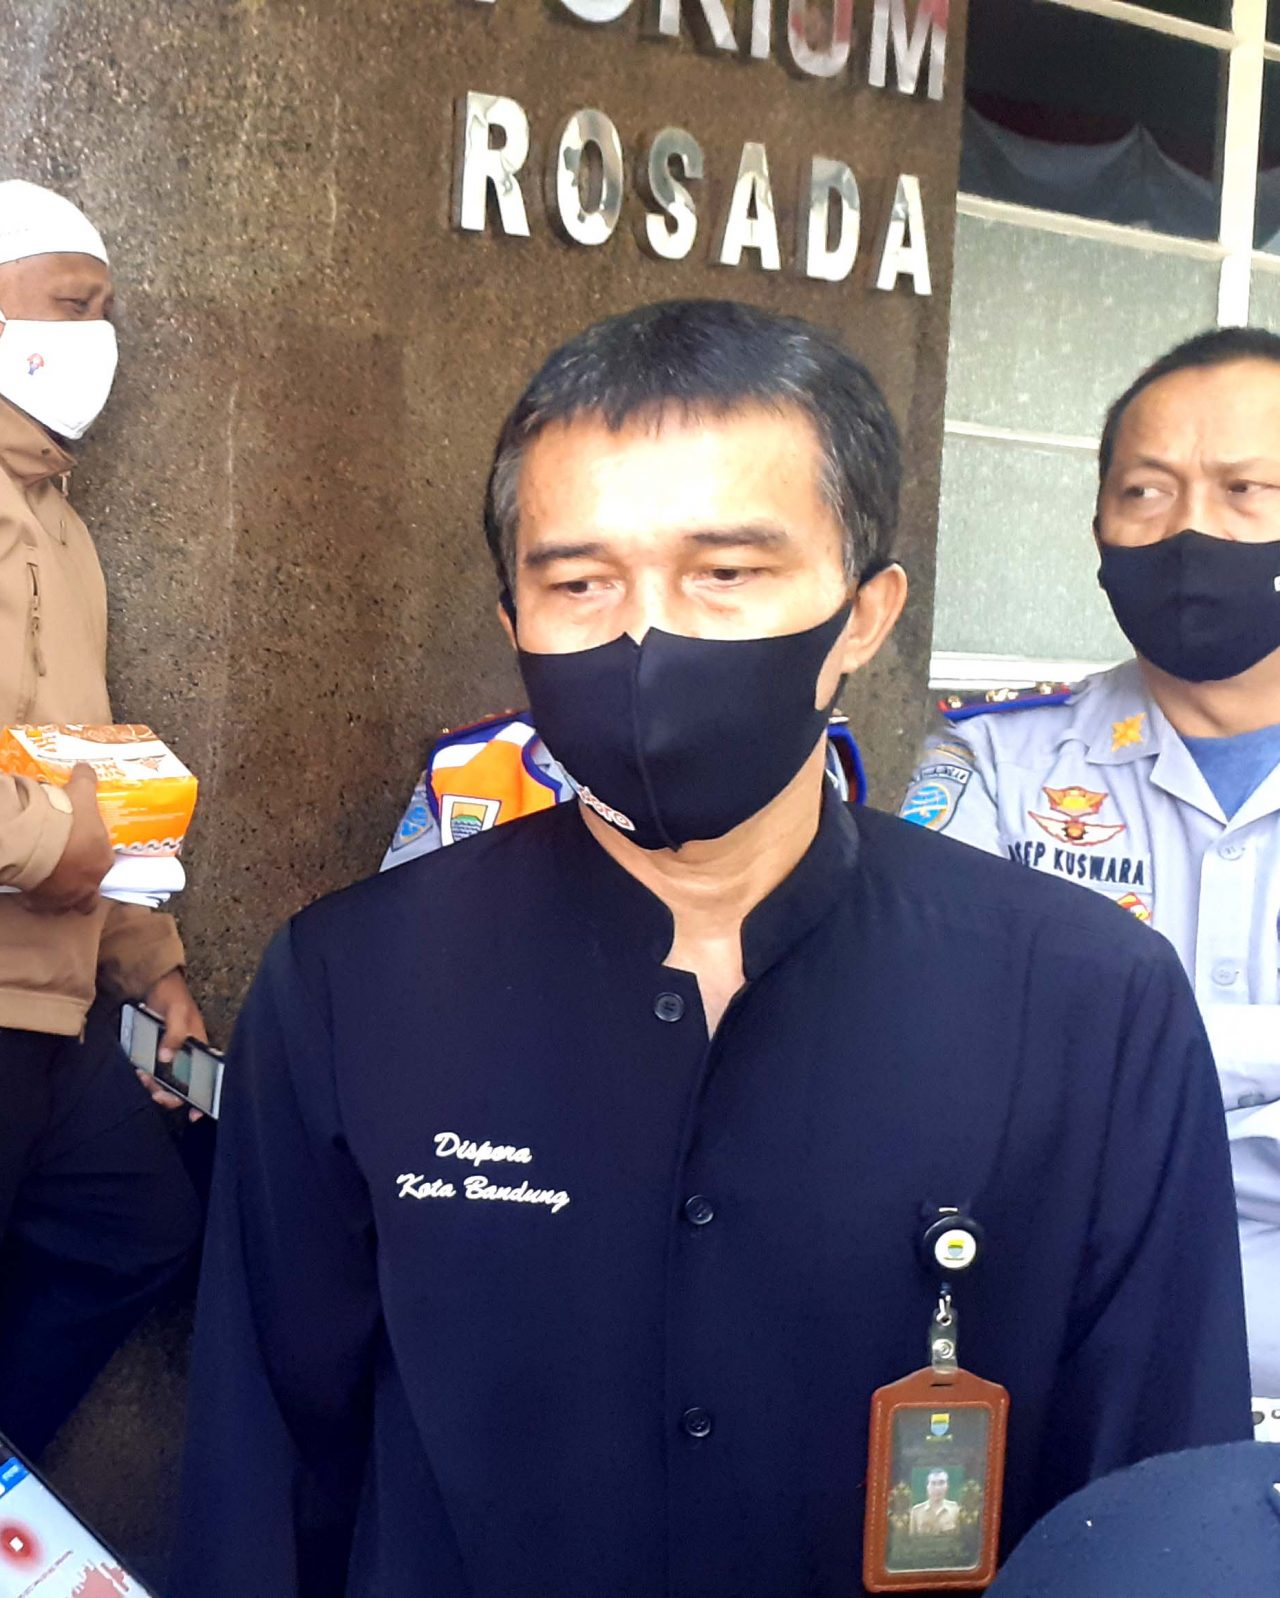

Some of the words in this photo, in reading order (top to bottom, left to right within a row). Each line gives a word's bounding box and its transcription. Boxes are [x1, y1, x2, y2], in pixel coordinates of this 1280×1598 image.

[458, 91, 933, 296] ROSADA
[1053, 847, 1145, 886] KUSWARA
[433, 1131, 533, 1167] Dispora
[396, 1173, 457, 1199] Kota
[463, 1175, 570, 1214] Bandung
